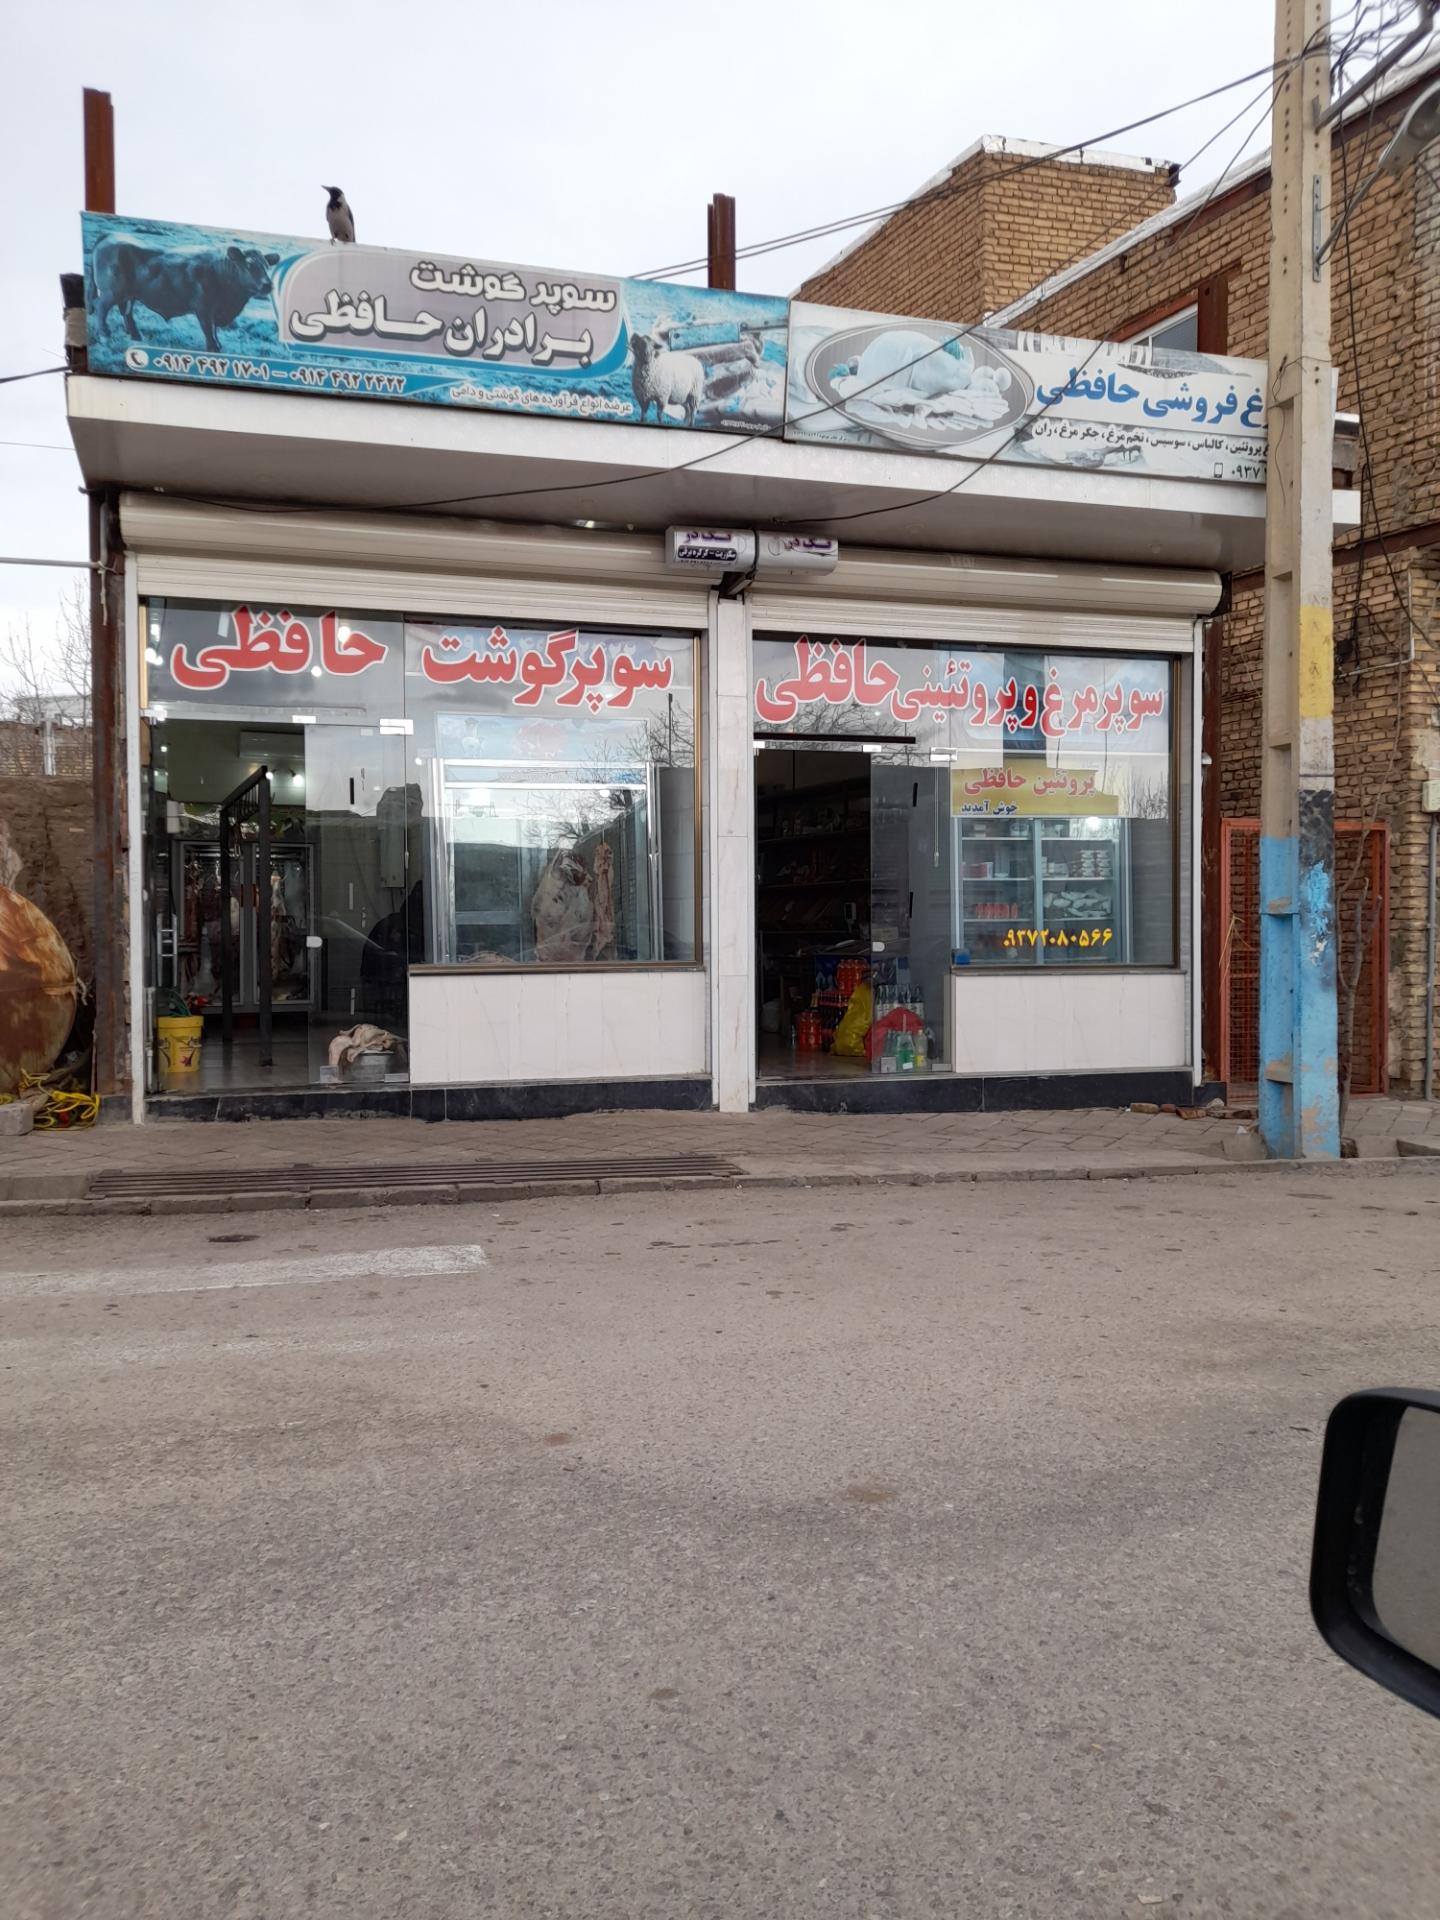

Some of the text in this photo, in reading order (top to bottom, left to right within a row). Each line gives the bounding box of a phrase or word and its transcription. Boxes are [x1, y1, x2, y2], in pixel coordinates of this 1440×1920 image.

[410, 260, 616, 316] سوپر گوشت
[289, 289, 593, 368] برادران حافظی
[486, 388, 520, 404] گوشتی
[1036, 367, 1140, 405] حافظی
[1143, 382, 1238, 424] فروشی
[579, 397, 603, 414] انواع
[605, 399, 632, 413] عرضه
[170, 605, 672, 714] سوپر گوشت حافظی
[755, 634, 1164, 738] سوپر مرغ و پروتئینی حافظی
[964, 767, 1026, 795] حافظی
[993, 800, 1018, 815] خوش
